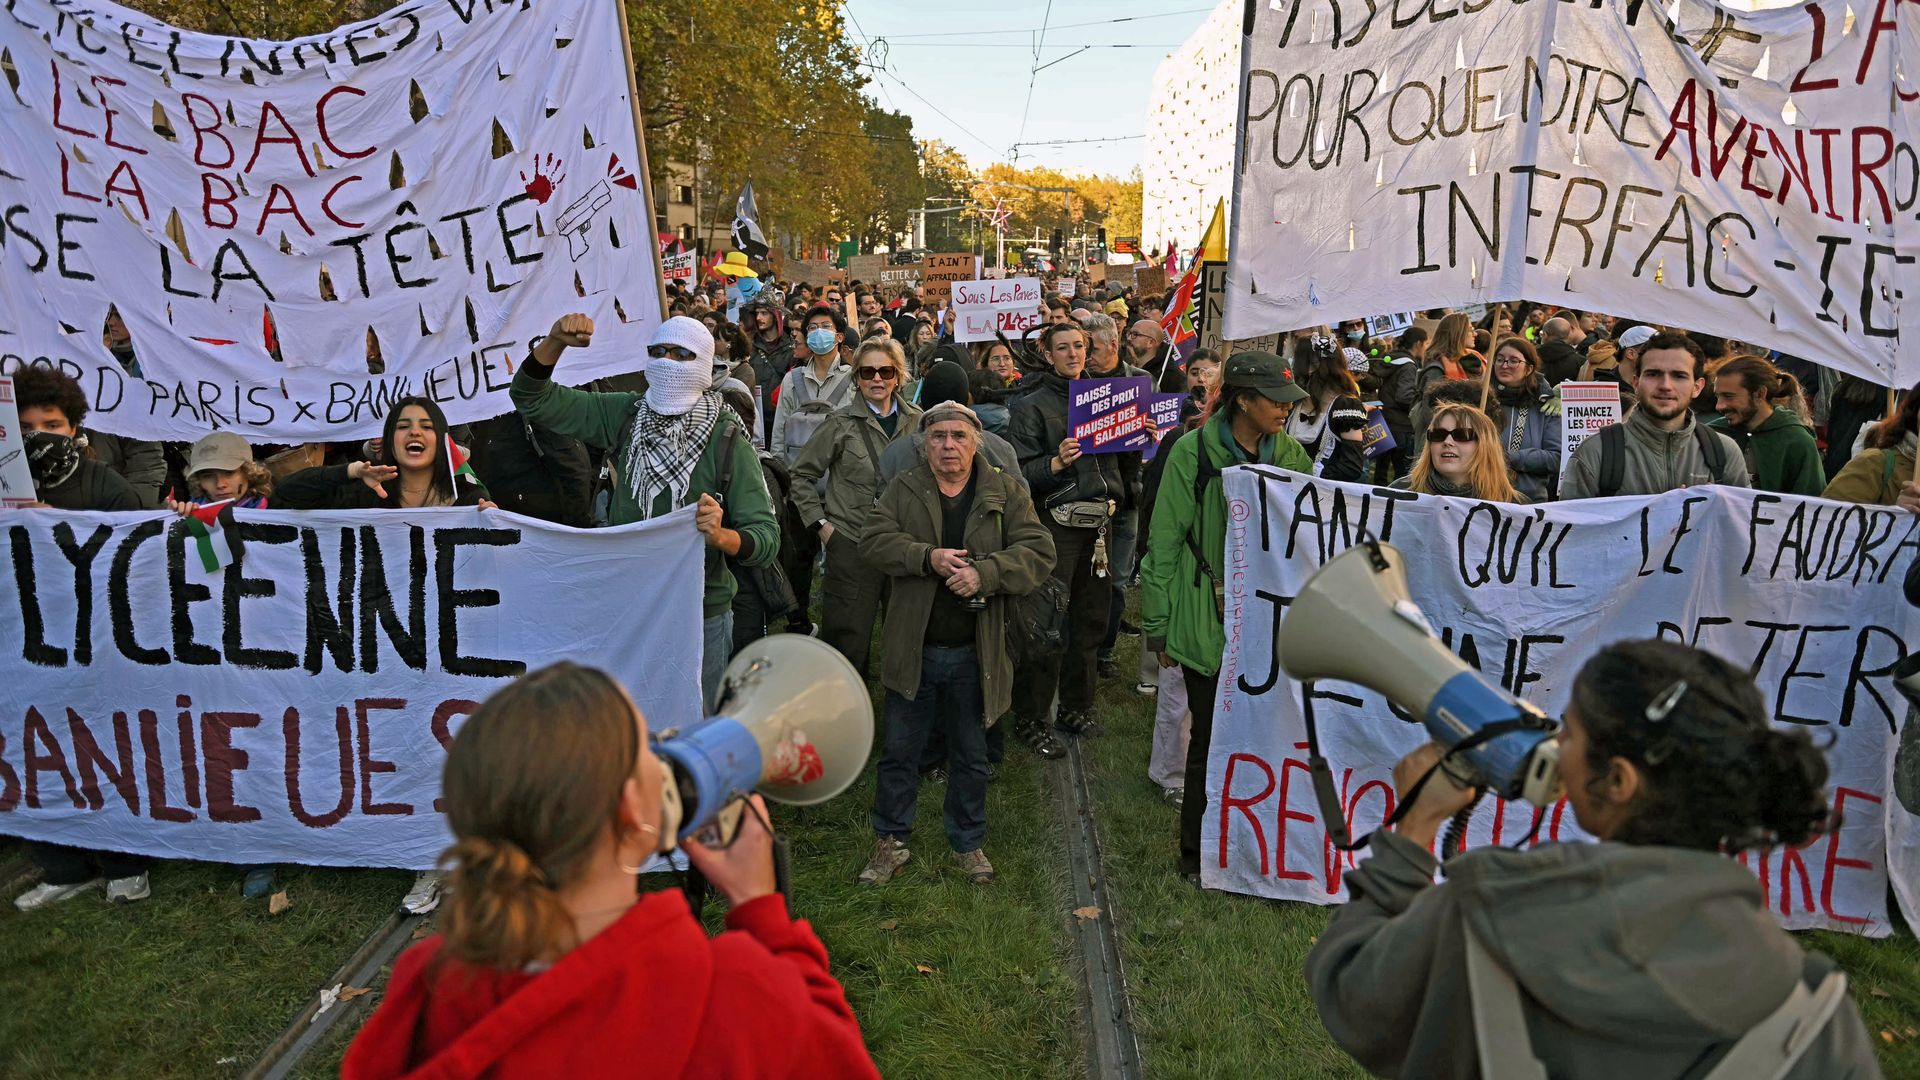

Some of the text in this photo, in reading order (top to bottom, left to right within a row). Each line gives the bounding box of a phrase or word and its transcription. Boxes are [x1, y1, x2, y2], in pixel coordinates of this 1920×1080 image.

[51, 58, 378, 178] LE BAC
[1244, 69, 1379, 175] POUR
[1387, 64, 1509, 146] QUE
[1653, 78, 1894, 225] AVENIR
[56, 141, 366, 237] LA BAC
[0, 190, 544, 302] SE LA TÊTE
[938, 257, 970, 267] AIN'T
[881, 269, 921, 281] BETTER A
[926, 273, 958, 282] AFFRAID
[926, 287, 936, 297] NO
[956, 286, 986, 304] Sous
[990, 285, 1012, 304] Les
[1013, 283, 1039, 302] Pavés
[967, 311, 1039, 334] LA PLAGE
[1075, 383, 1112, 407] BAISSE
[1091, 398, 1111, 415] DES
[1567, 406, 1613, 418] FINANCEZ
[1075, 406, 1136, 438] HAUSSE DES
[1156, 410, 1178, 425] DES
[1568, 419, 1584, 430] LES
[1095, 418, 1142, 446] SALAIRES
[1568, 434, 1581, 442] PAS
[1240, 468, 1419, 568] TANT
[1458, 501, 1577, 589] QU'IL
[1637, 496, 1708, 578] LE
